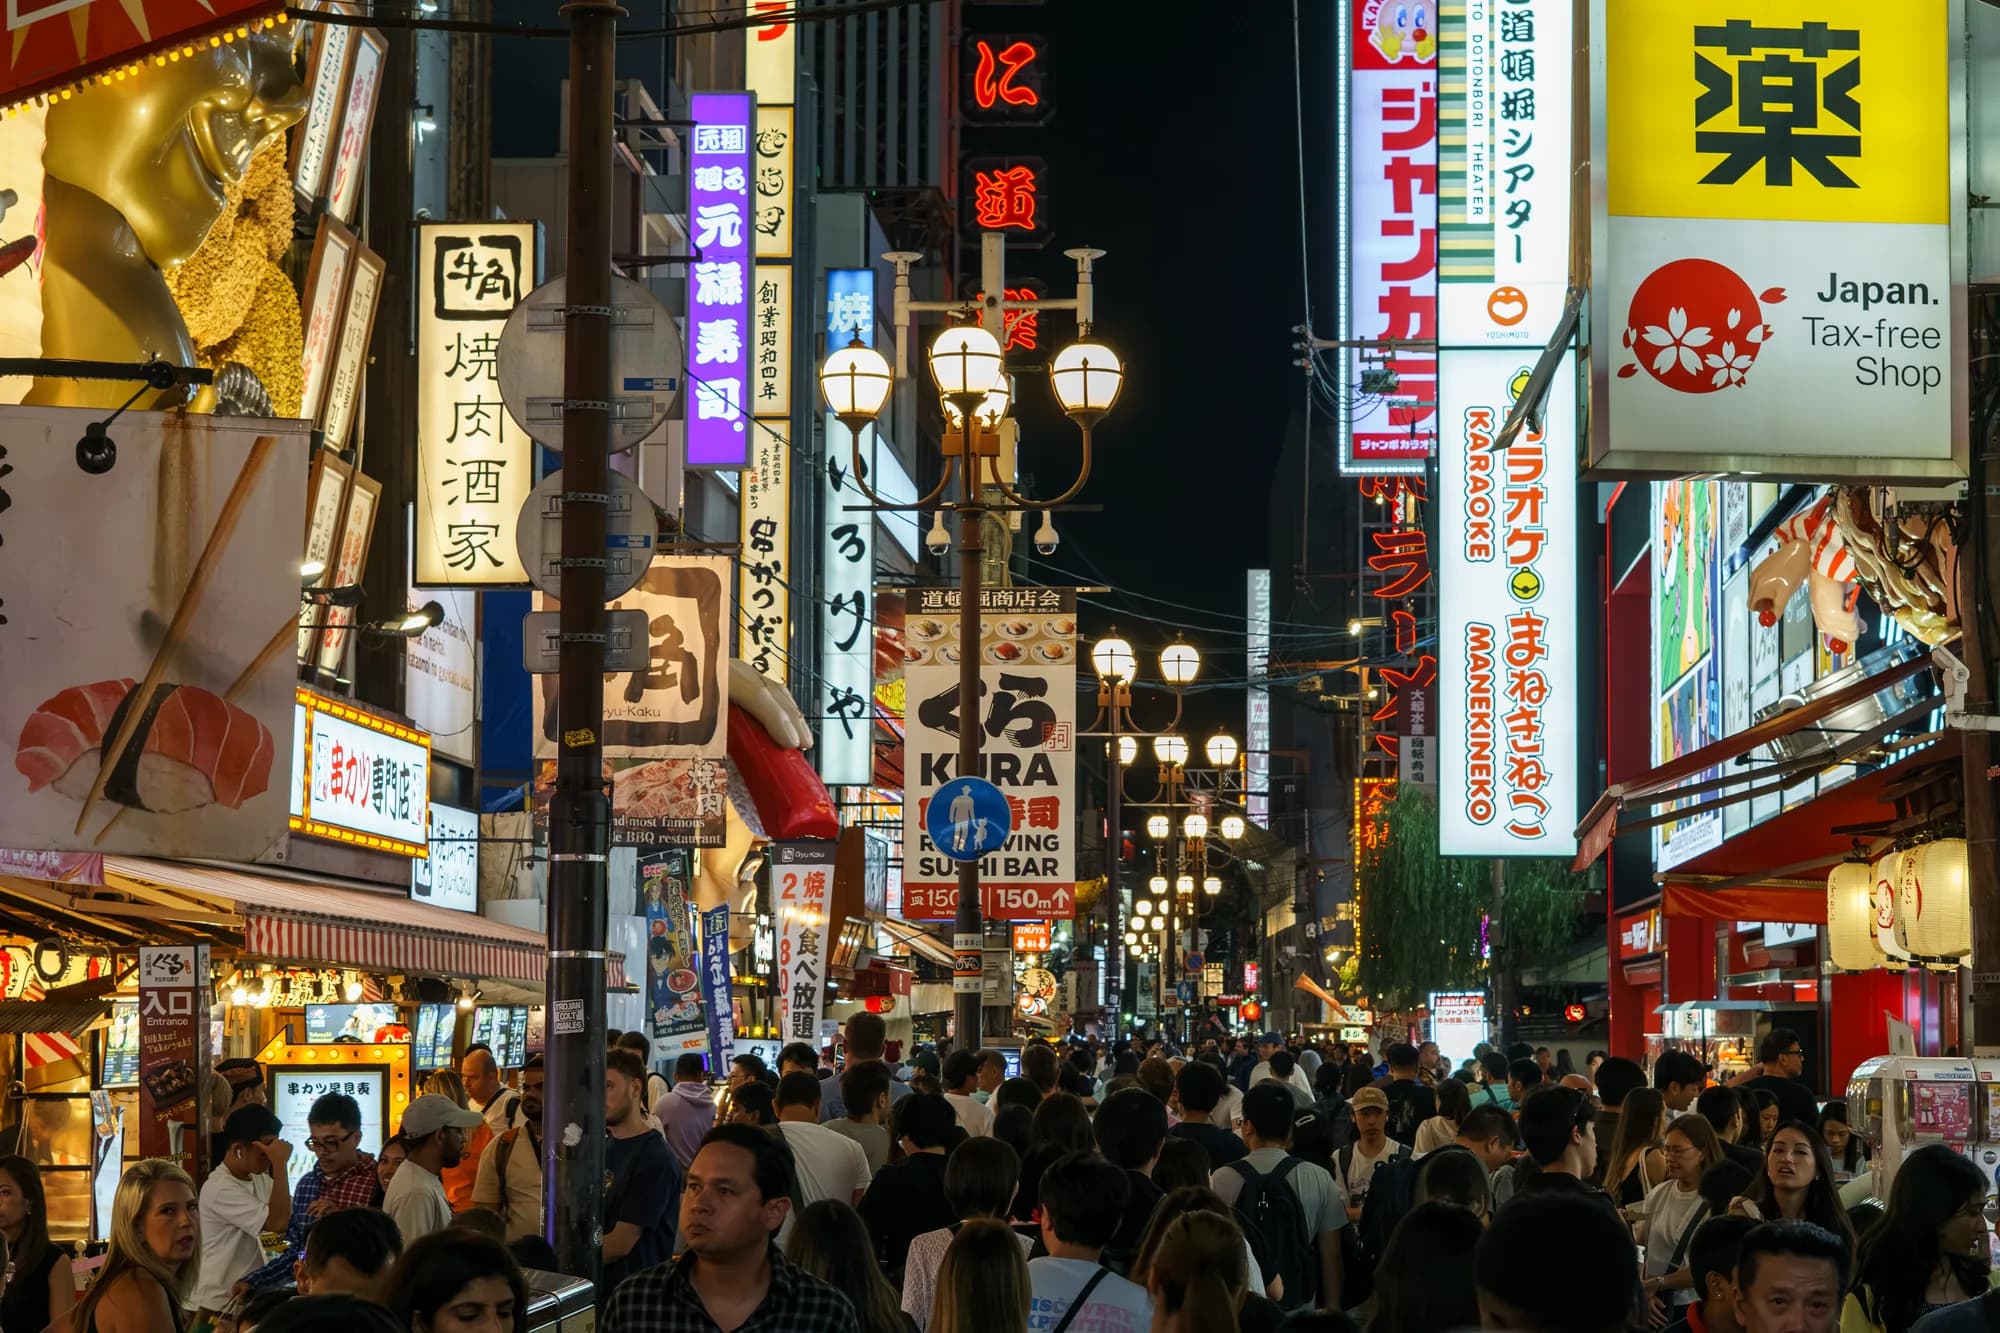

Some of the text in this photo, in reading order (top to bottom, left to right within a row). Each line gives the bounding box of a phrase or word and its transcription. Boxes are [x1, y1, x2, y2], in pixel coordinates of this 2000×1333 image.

[301, 23, 338, 181] KUSHIKATSU
[1473, 34, 1484, 128] DOTONBORI
[1694, 19, 1862, 189] 薬
[700, 127, 742, 151] 元祖
[1500, 0, 1536, 264] 道頓堀シアター
[1473, 142, 1484, 216] THEATER
[446, 251, 512, 301] 牛角
[1817, 272, 1940, 311] Japan.
[757, 280, 780, 401] 創業昭和四年
[1486, 331, 1529, 340] YOSHIMOTO
[1801, 316, 1942, 350] Tax-free
[1855, 355, 1942, 395] Shop
[442, 332, 507, 571] 焼肉酒家
[1469, 411, 1490, 558] KARAOKE
[827, 454, 869, 741] いろりや
[603, 705, 662, 719] yu-Kaku
[1470, 626, 1492, 822] MANEKINEKO
[1506, 610, 1549, 837] まねきねこ
[688, 760, 726, 817] 焼肉
[626, 830, 656, 845] BBQ
[658, 831, 722, 845] restaurant
[629, 816, 659, 829] most
[661, 815, 706, 829] famous
[919, 834, 1060, 852] RVING
[1003, 857, 1060, 877] BAR
[996, 888, 1052, 908] 150m
[792, 871, 827, 1040] 焼肉食べ放題
[142, 991, 192, 1017] 入口
[146, 1017, 189, 1027] Entrance
